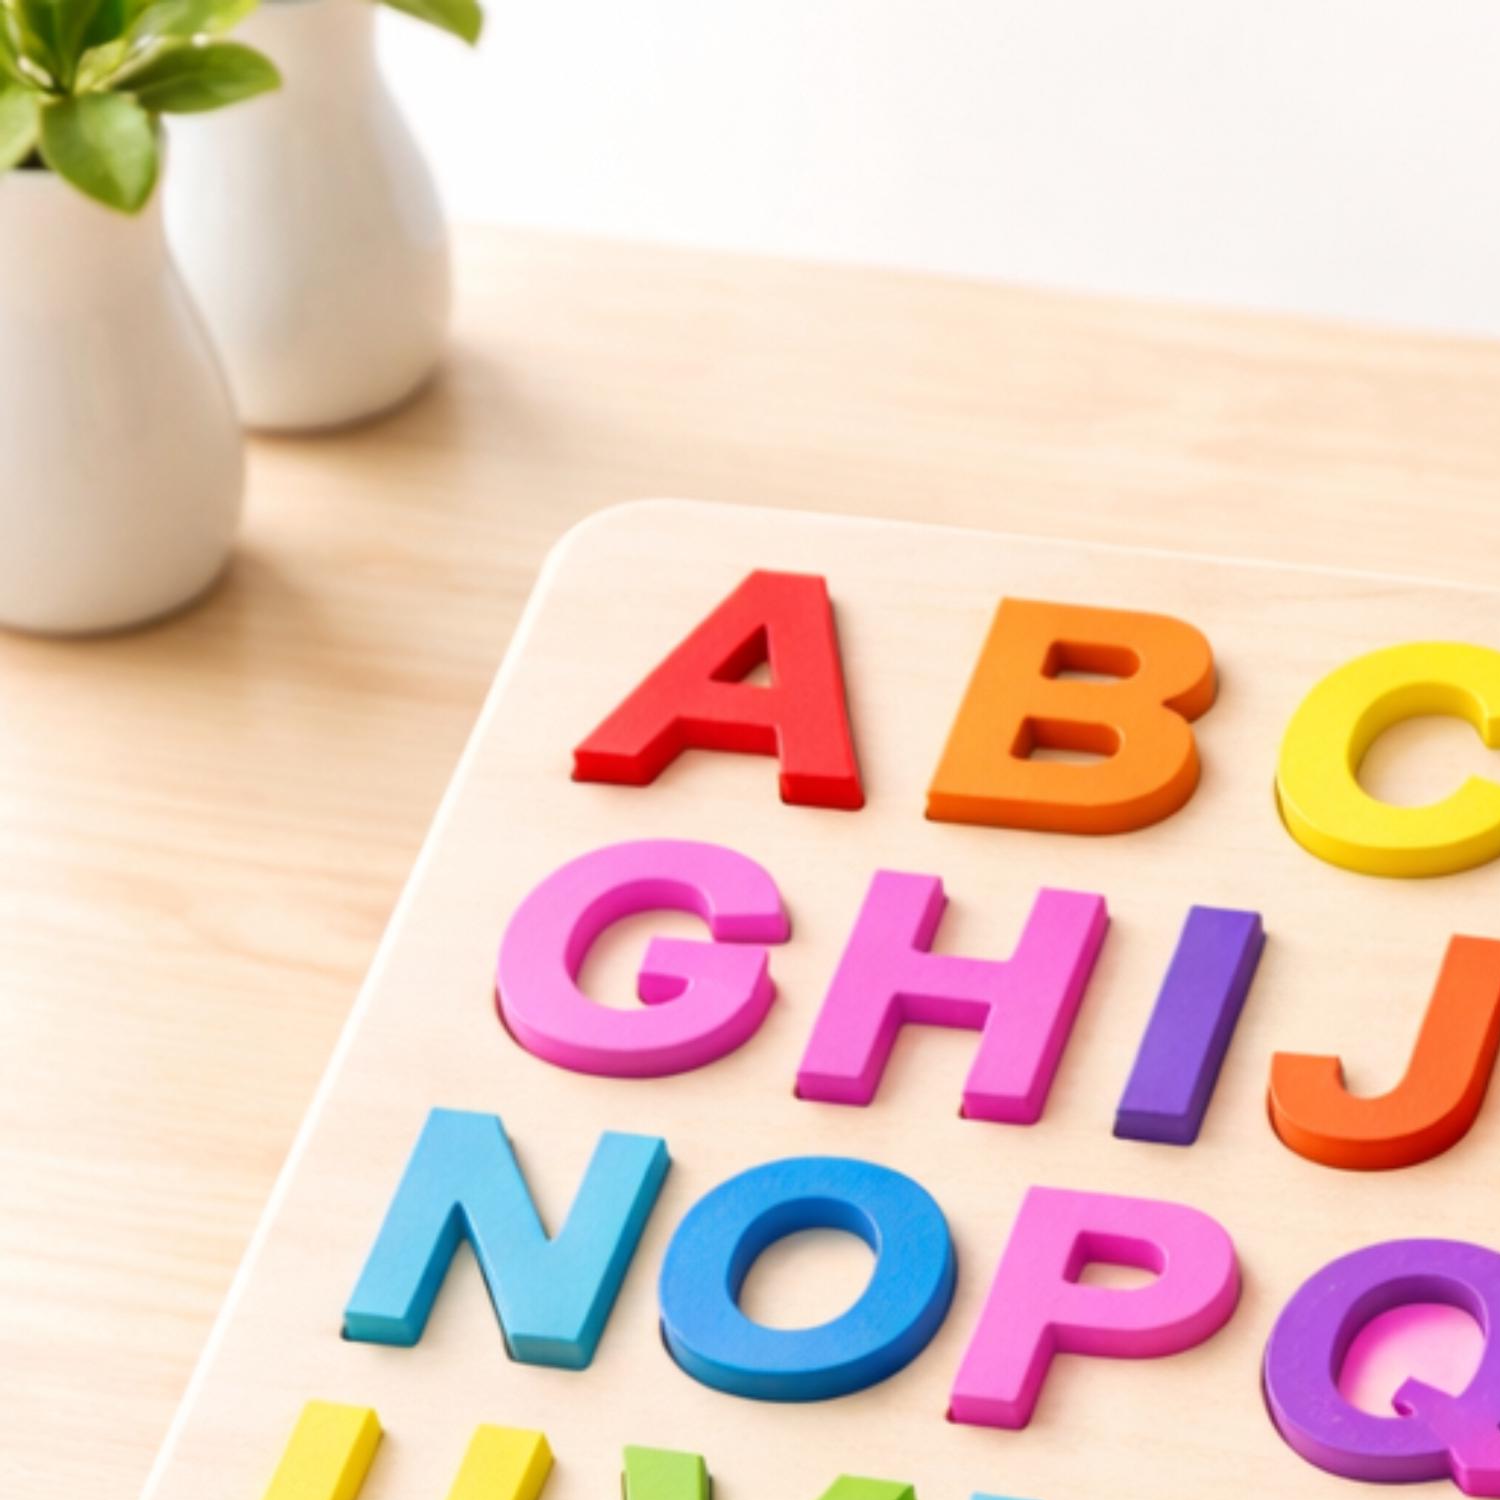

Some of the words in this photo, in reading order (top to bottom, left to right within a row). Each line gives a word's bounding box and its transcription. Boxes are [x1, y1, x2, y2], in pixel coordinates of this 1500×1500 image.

[571, 569, 867, 812] A
[924, 597, 1219, 837] B
[495, 838, 791, 1079] G
[795, 870, 1109, 1126] H
[1113, 906, 1264, 1144] I
[343, 1106, 671, 1371] N
[658, 1155, 957, 1402] O
[946, 1186, 1244, 1430] P
